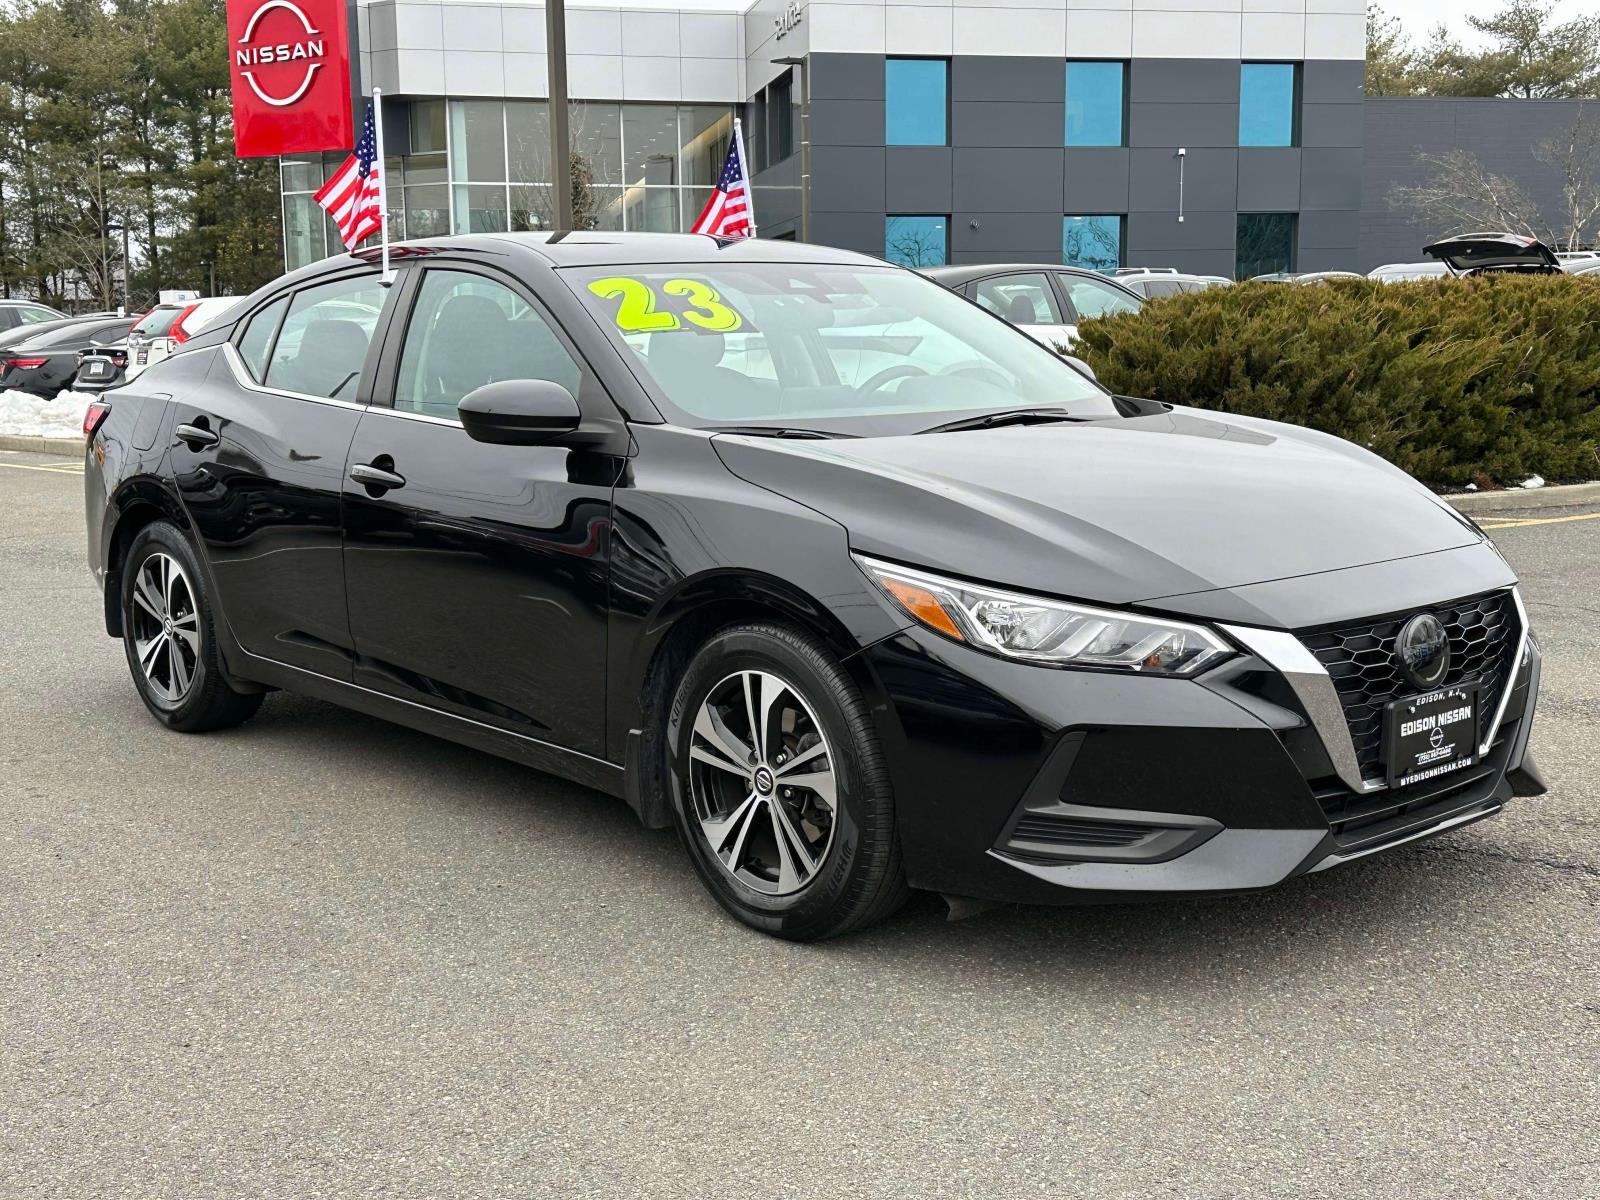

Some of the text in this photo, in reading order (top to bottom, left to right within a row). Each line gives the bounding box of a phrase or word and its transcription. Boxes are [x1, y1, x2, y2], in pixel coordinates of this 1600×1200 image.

[236, 40, 323, 66] NISSAN
[587, 277, 743, 332] 23
[1401, 706, 1471, 736] EDISON NISSAN
[1401, 758, 1471, 786] MYEDISONNISSAN.COM
